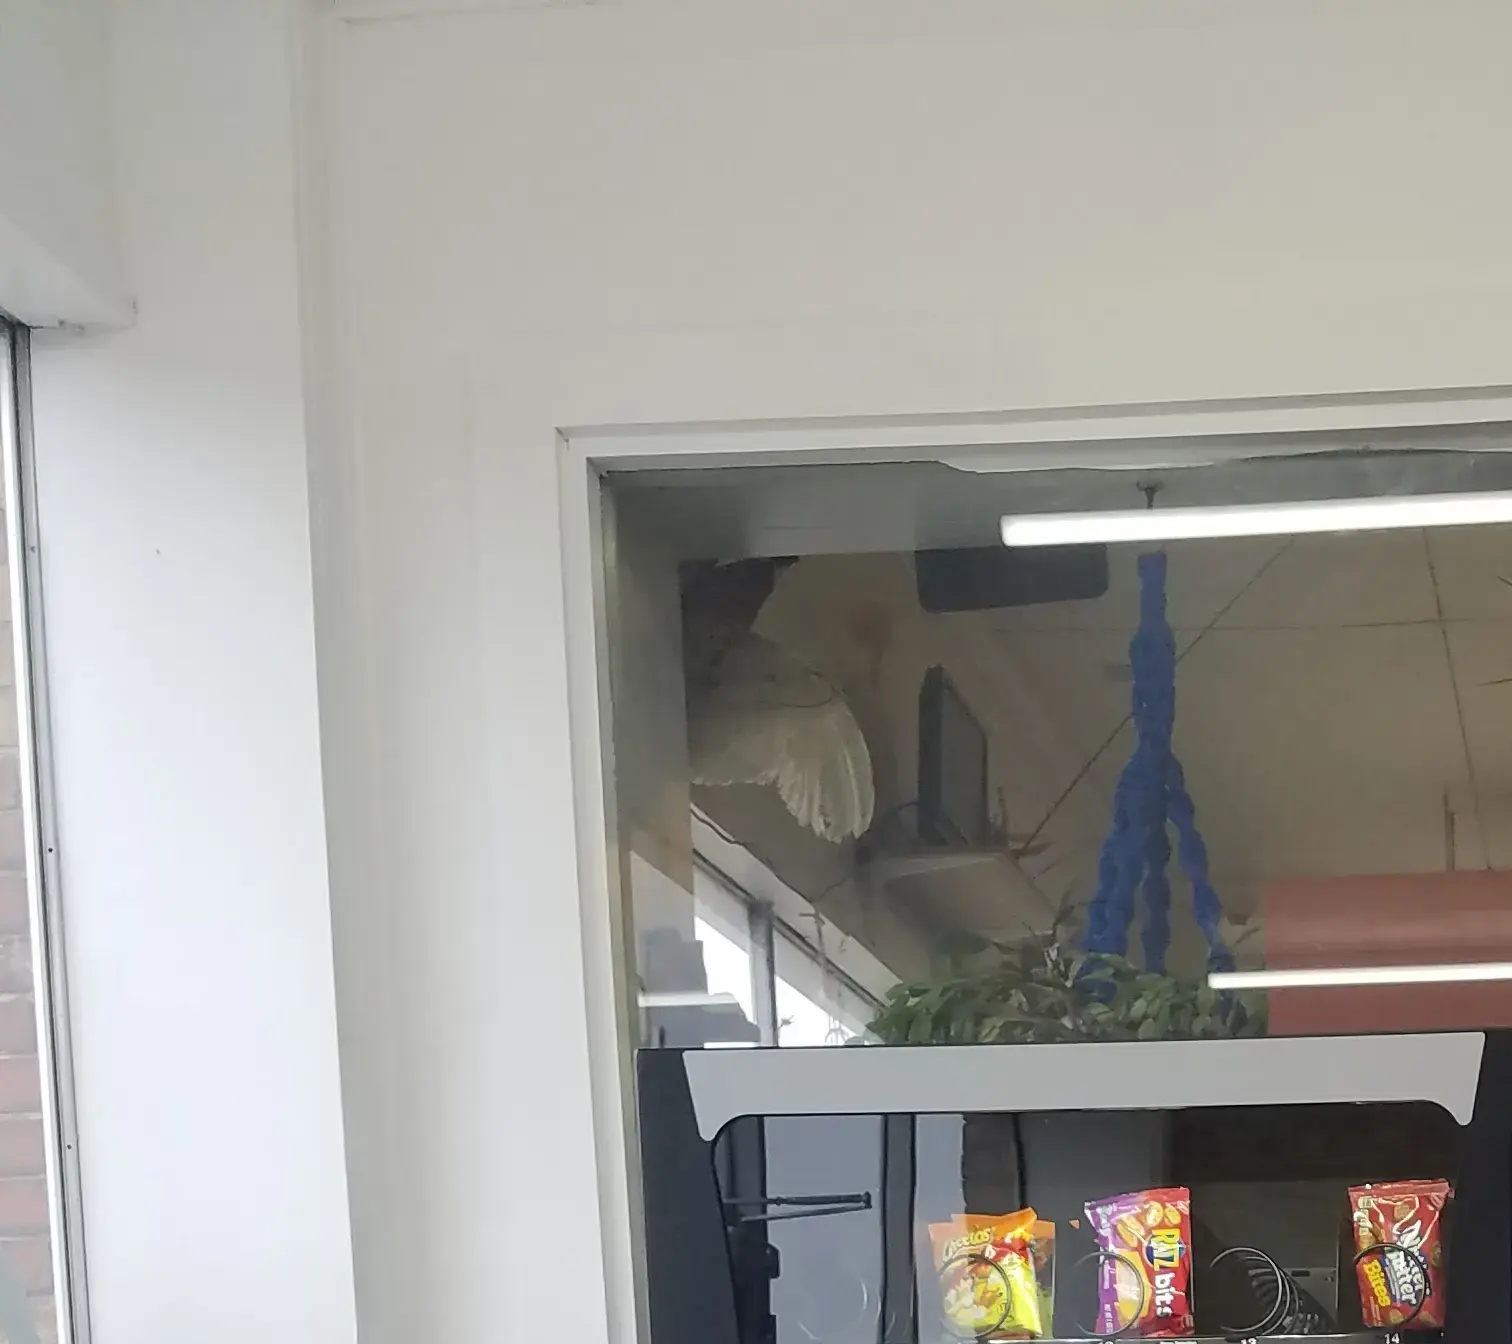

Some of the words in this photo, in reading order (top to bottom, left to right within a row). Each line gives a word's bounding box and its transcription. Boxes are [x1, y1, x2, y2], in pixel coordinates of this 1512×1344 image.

[1153, 1272, 1175, 1317] bits
[1363, 1259, 1391, 1307] Bites
[1385, 1333, 1400, 1344] 14
